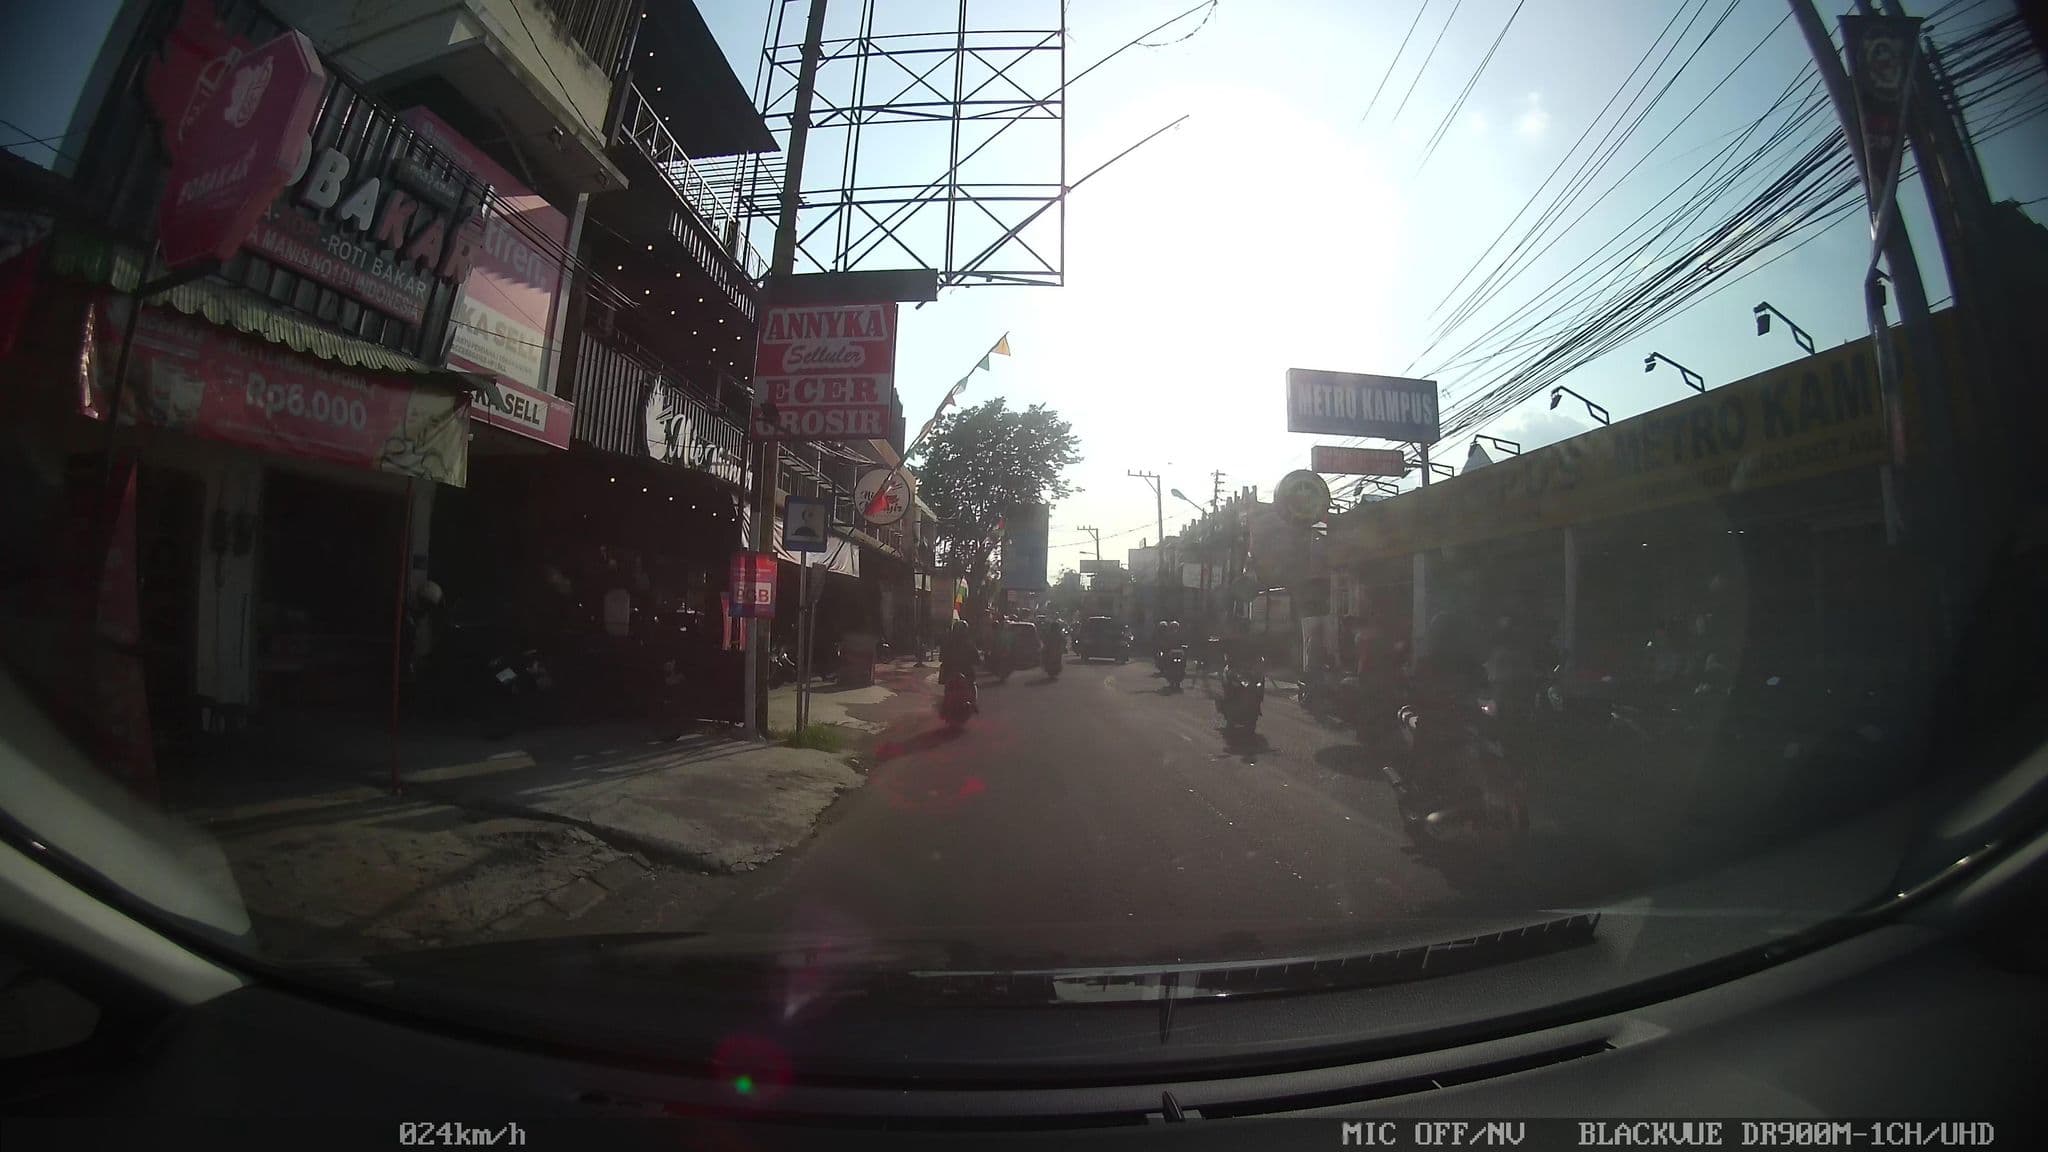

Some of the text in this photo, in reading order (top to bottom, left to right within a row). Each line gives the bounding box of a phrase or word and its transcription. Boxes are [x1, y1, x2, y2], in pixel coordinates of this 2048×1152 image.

[371, 256, 426, 299] BAKAR
[766, 308, 886, 342] ANNYKA
[246, 370, 367, 432] Rp6.000
[505, 392, 540, 425] SELL
[766, 377, 879, 404] ECER
[1298, 383, 1433, 425] METRO KAMPUS
[1614, 395, 1748, 474] METRO
[1761, 353, 1876, 441] KAM
